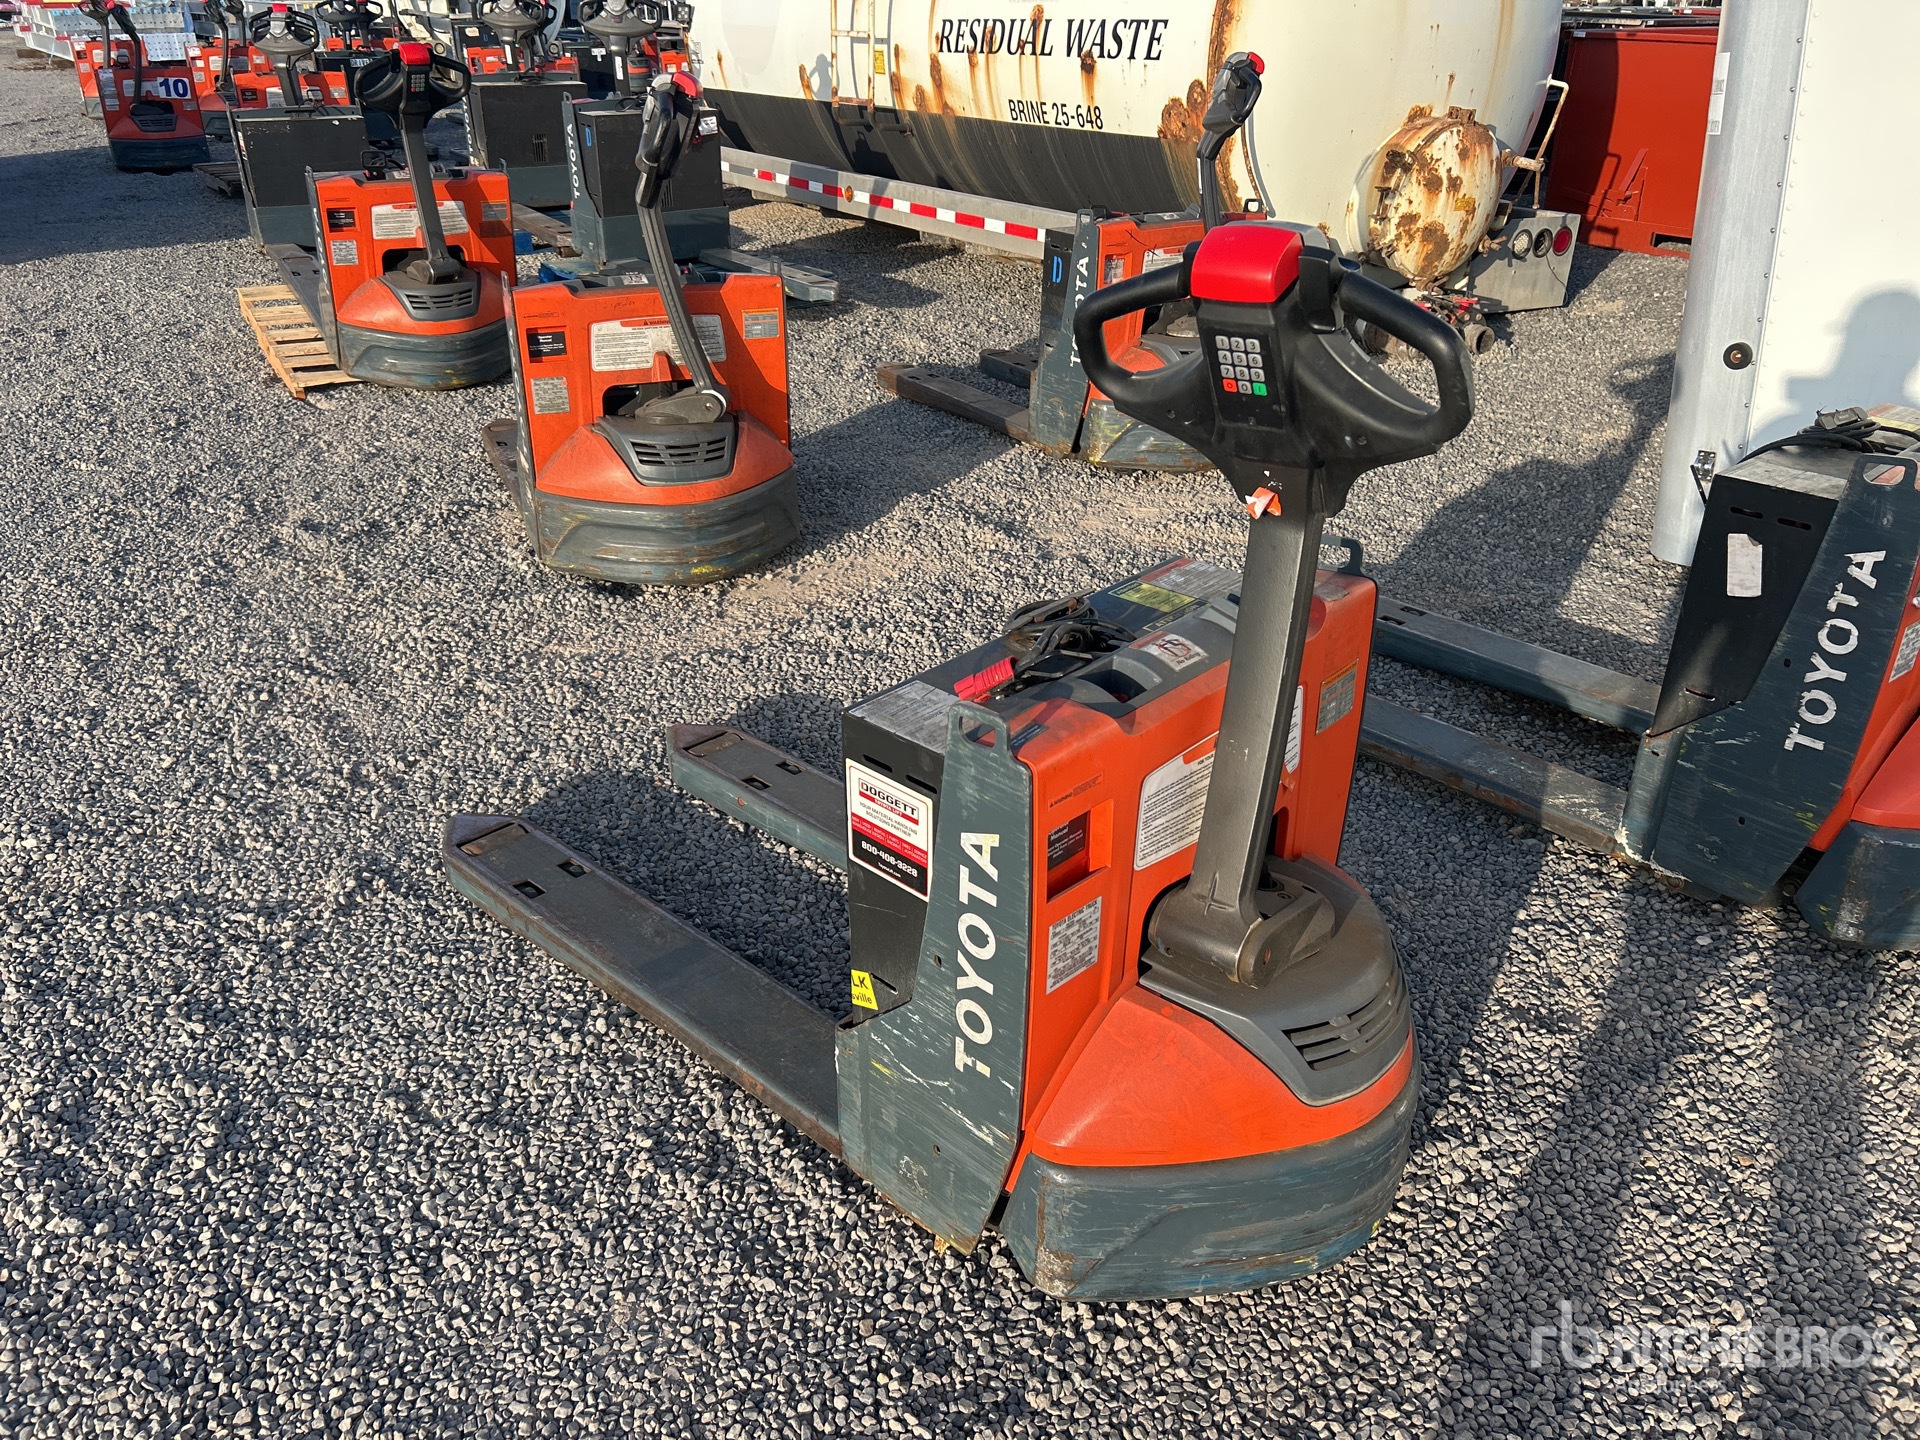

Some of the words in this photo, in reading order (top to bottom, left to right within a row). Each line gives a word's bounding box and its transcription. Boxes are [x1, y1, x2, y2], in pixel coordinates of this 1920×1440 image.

[938, 18, 1054, 56] RESIDUAL
[1065, 19, 1170, 60] WASTE
[159, 77, 189, 98] 10
[1008, 98, 1050, 125] BRINE
[1051, 103, 1104, 130] 25-648
[566, 123, 581, 199] TOYOTA
[1784, 549, 1887, 752] TOYOTA
[861, 782, 917, 816] DOGGETT
[954, 831, 1000, 1079] TOYOTA
